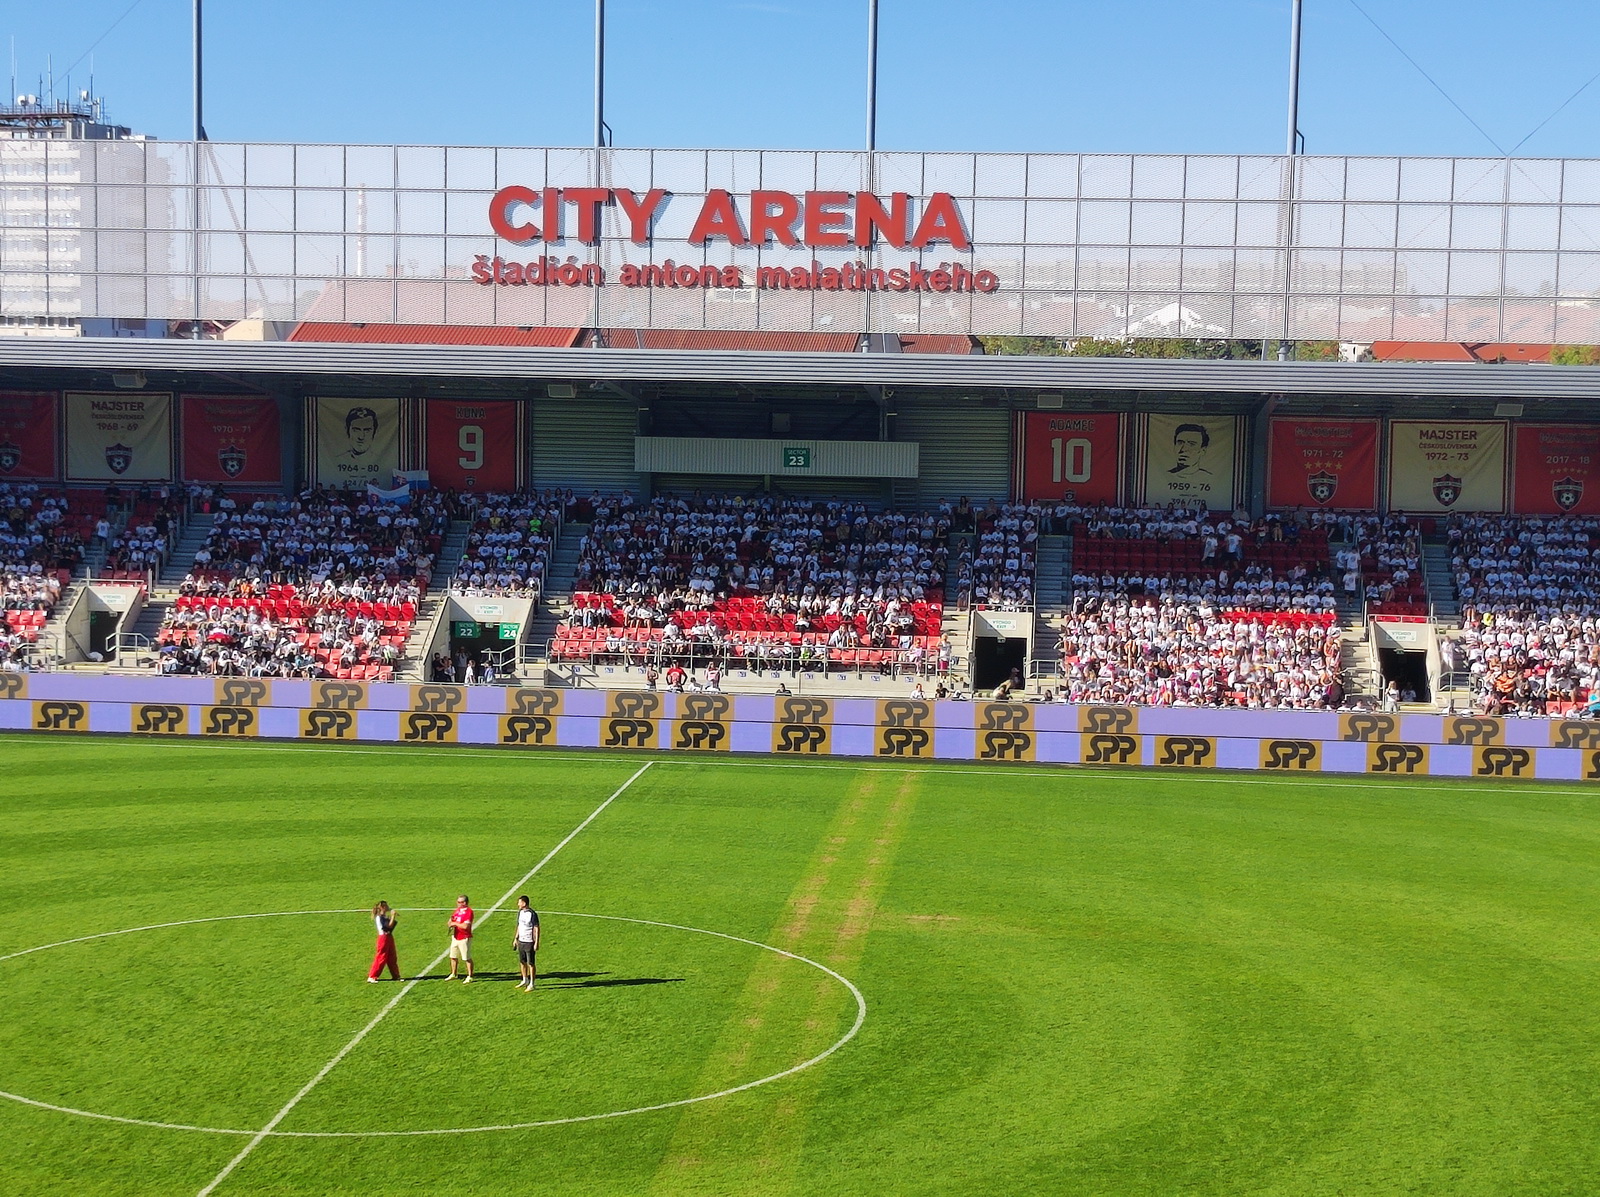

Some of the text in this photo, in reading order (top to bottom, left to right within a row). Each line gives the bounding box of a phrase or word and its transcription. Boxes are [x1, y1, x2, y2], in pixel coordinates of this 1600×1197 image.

[488, 186, 972, 249] CITY ARENA
[471, 254, 1000, 293] štadión antona malatinského
[91, 401, 145, 412] MAJSTER
[456, 407, 486, 419] KUNA
[97, 423, 119, 432] 1968
[127, 424, 139, 432] 69
[212, 425, 234, 433] 1970
[1049, 419, 1095, 432] ADAMEC
[1419, 430, 1477, 440] MAJSTER
[458, 425, 484, 470] 9
[1302, 449, 1323, 458] 1971
[1332, 450, 1344, 458] 72
[1418, 442, 1477, 450] ČESKOSLOVENSKA
[1425, 452, 1448, 461] 1972
[1457, 453, 1469, 461] 73
[337, 463, 359, 472] 1964
[367, 464, 379, 472] 80
[789, 456, 805, 466] 23
[1051, 437, 1092, 483] 10
[1546, 455, 1570, 464] 2017
[1580, 456, 1590, 465] 18
[1168, 482, 1190, 491] 1959
[1200, 483, 1211, 491] 76
[460, 628, 473, 636] 22
[503, 629, 516, 638] 24
[219, 680, 266, 705] SPP
[316, 683, 364, 707] SPP
[414, 685, 462, 710] SPP
[511, 689, 559, 713] SPP
[611, 692, 659, 717] SPP
[36, 701, 85, 730] SPP
[136, 704, 184, 733] SPP
[681, 693, 730, 719] SPP
[779, 695, 829, 722] SPP
[879, 699, 930, 725] SPP
[979, 703, 1030, 729] SPP
[205, 706, 254, 735] SPP
[304, 709, 353, 738] SPP
[404, 712, 453, 741] SPP
[502, 715, 552, 744] SPP
[604, 718, 654, 747] SPP
[1083, 707, 1133, 732] SPP
[1343, 714, 1395, 741] SPP
[1448, 717, 1500, 743] SPP
[675, 721, 726, 750] SPP
[776, 724, 827, 753] SPP
[879, 727, 930, 756] SPP
[980, 731, 1031, 760] SPP
[1085, 734, 1137, 763] SPP
[1159, 737, 1212, 766] SPP
[1264, 740, 1317, 769] SPP
[1371, 743, 1424, 772] SPP
[1477, 747, 1531, 775] SPP
